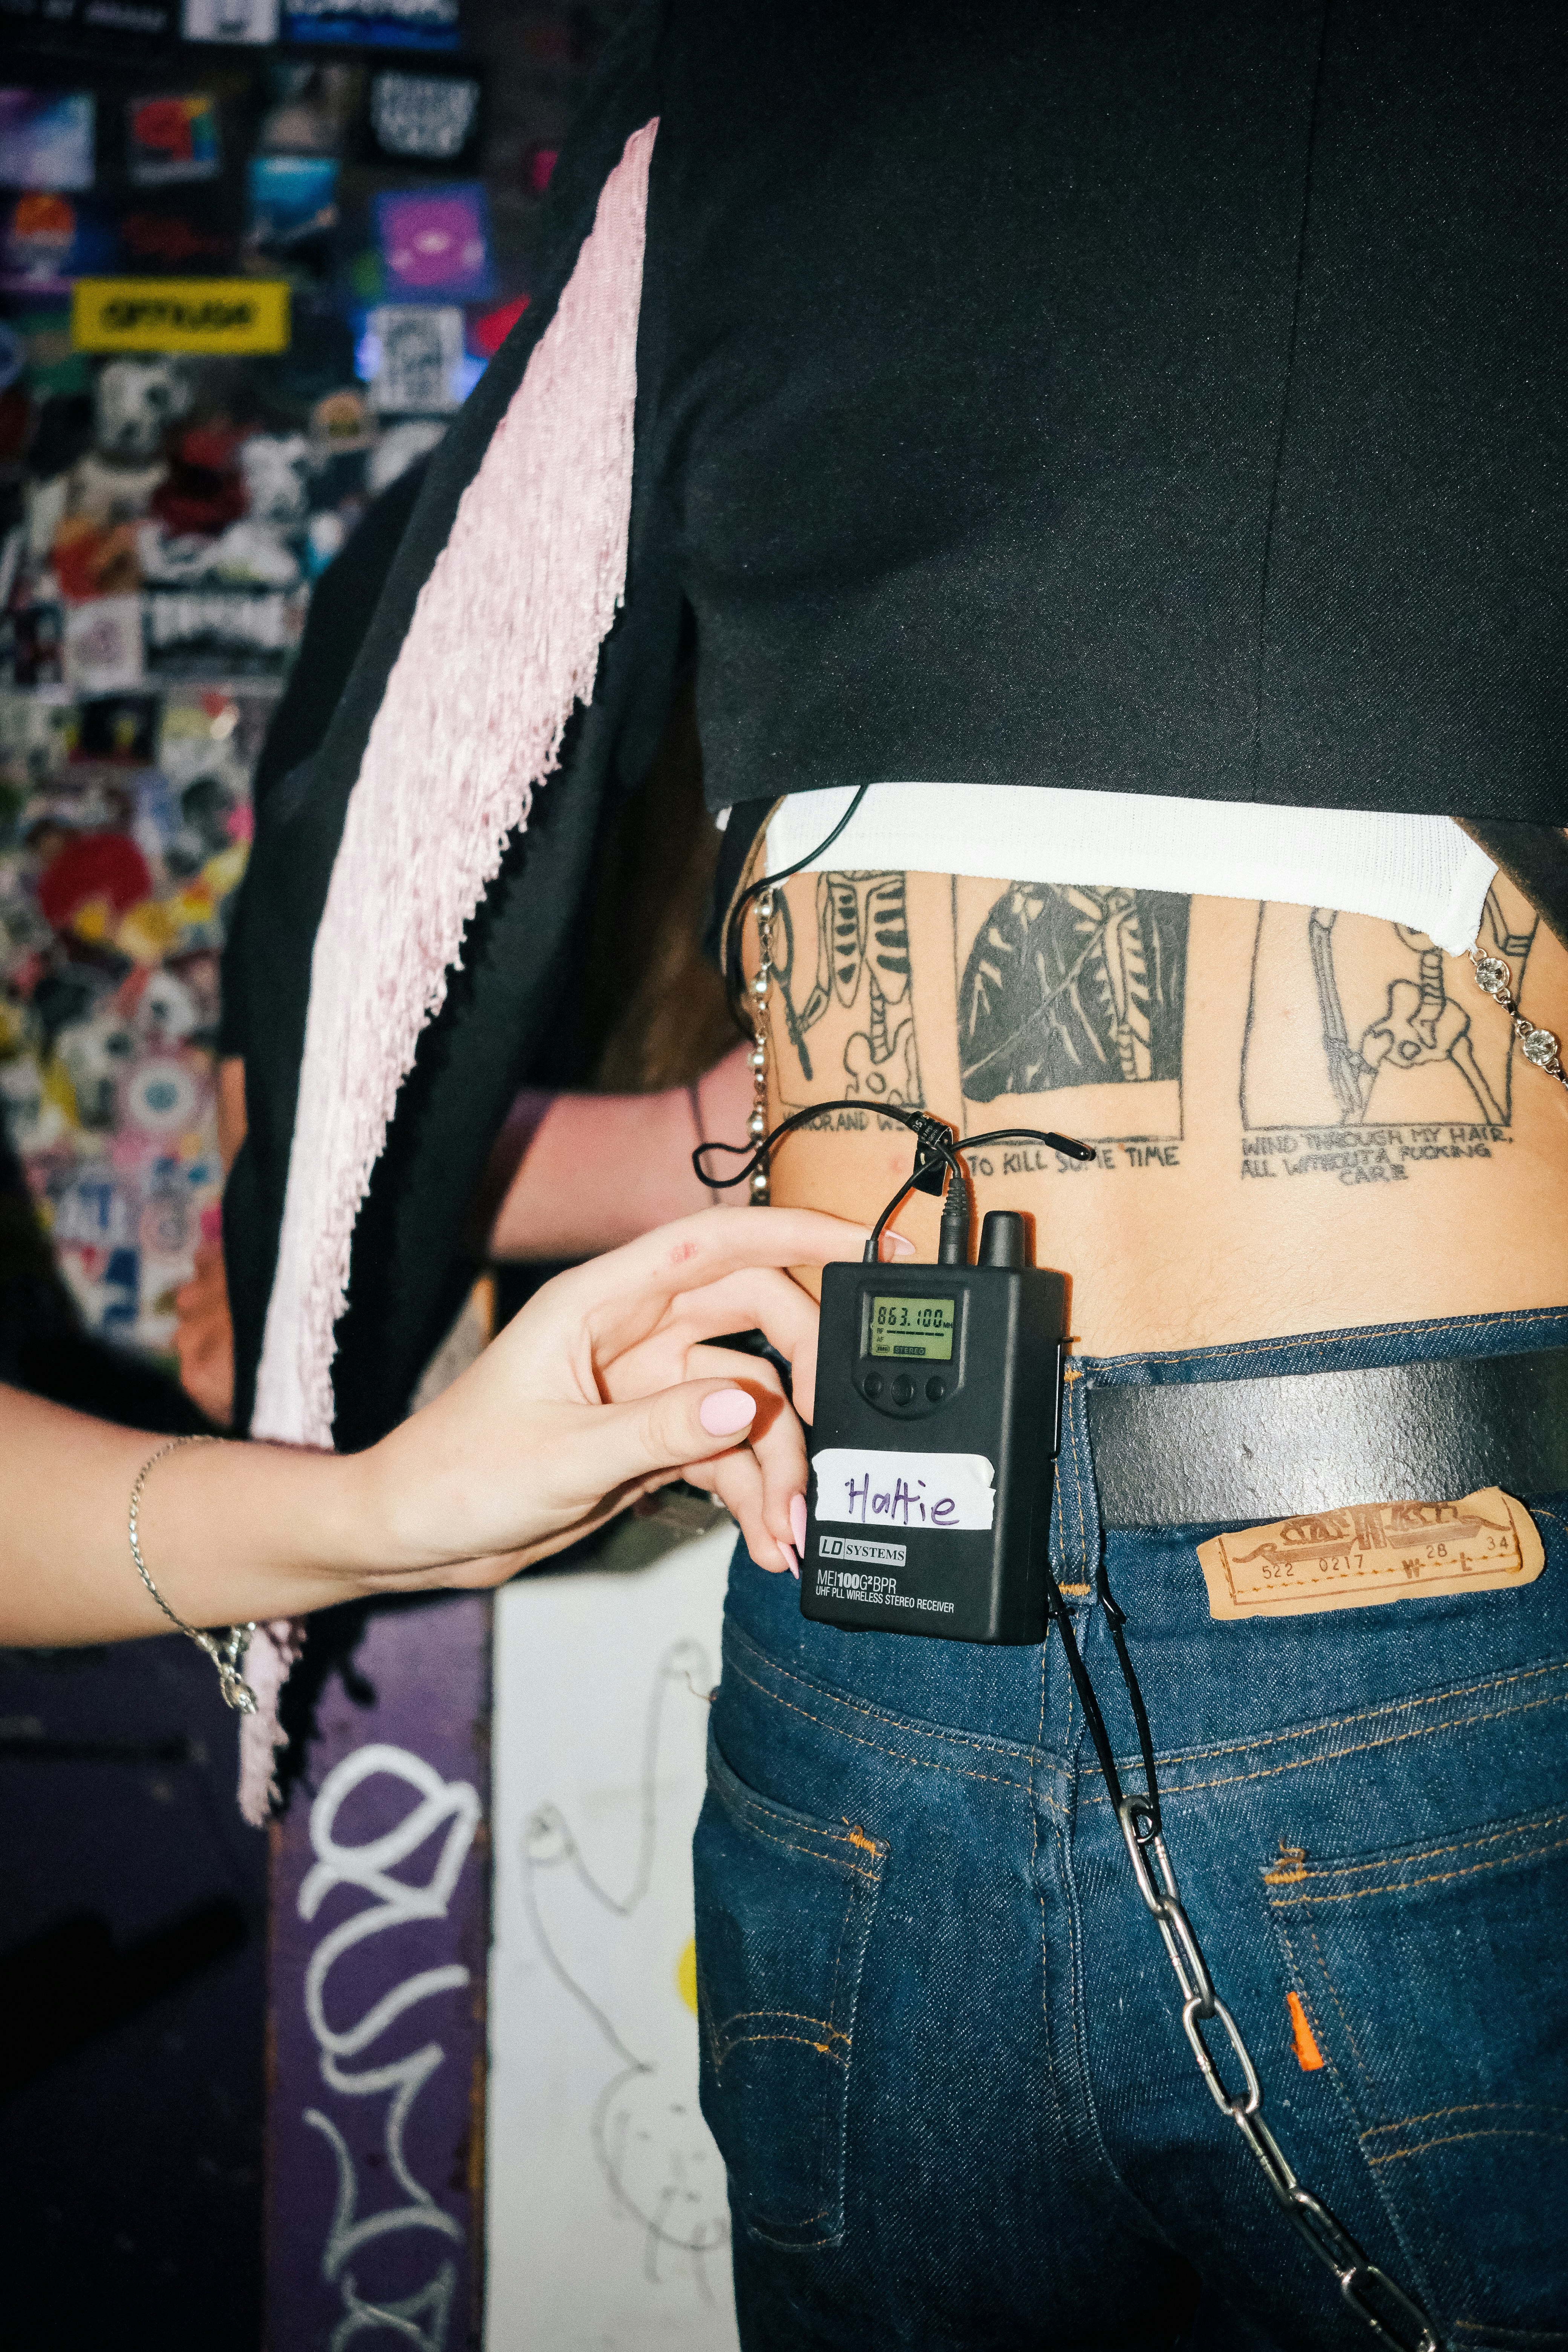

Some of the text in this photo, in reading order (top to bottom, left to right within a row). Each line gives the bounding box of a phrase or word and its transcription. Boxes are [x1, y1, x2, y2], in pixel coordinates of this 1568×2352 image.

[836, 1112, 868, 1131] AND
[1242, 1135, 1297, 1155] WIND
[1301, 1130, 1403, 1150] THROUGH
[1411, 1127, 1441, 1142] MY
[967, 1156, 994, 1176] TO
[1004, 1150, 1047, 1175] KILL
[1124, 1146, 1180, 1167] TIME
[1242, 1144, 1492, 1179] ALL WITHOUT A FUCKING
[1339, 1164, 1409, 1185] CARE
[877, 1306, 943, 1328] 863.100
[894, 1346, 925, 1355] STEREO
[845, 1473, 960, 1525] Hattie
[821, 1539, 905, 1561] LD SYSTEMS
[1262, 1535, 1509, 1579] 522 0217 W 28 L 34
[816, 1585, 954, 1613] UHF PLL WIRELESS STEREO RECEIVER
